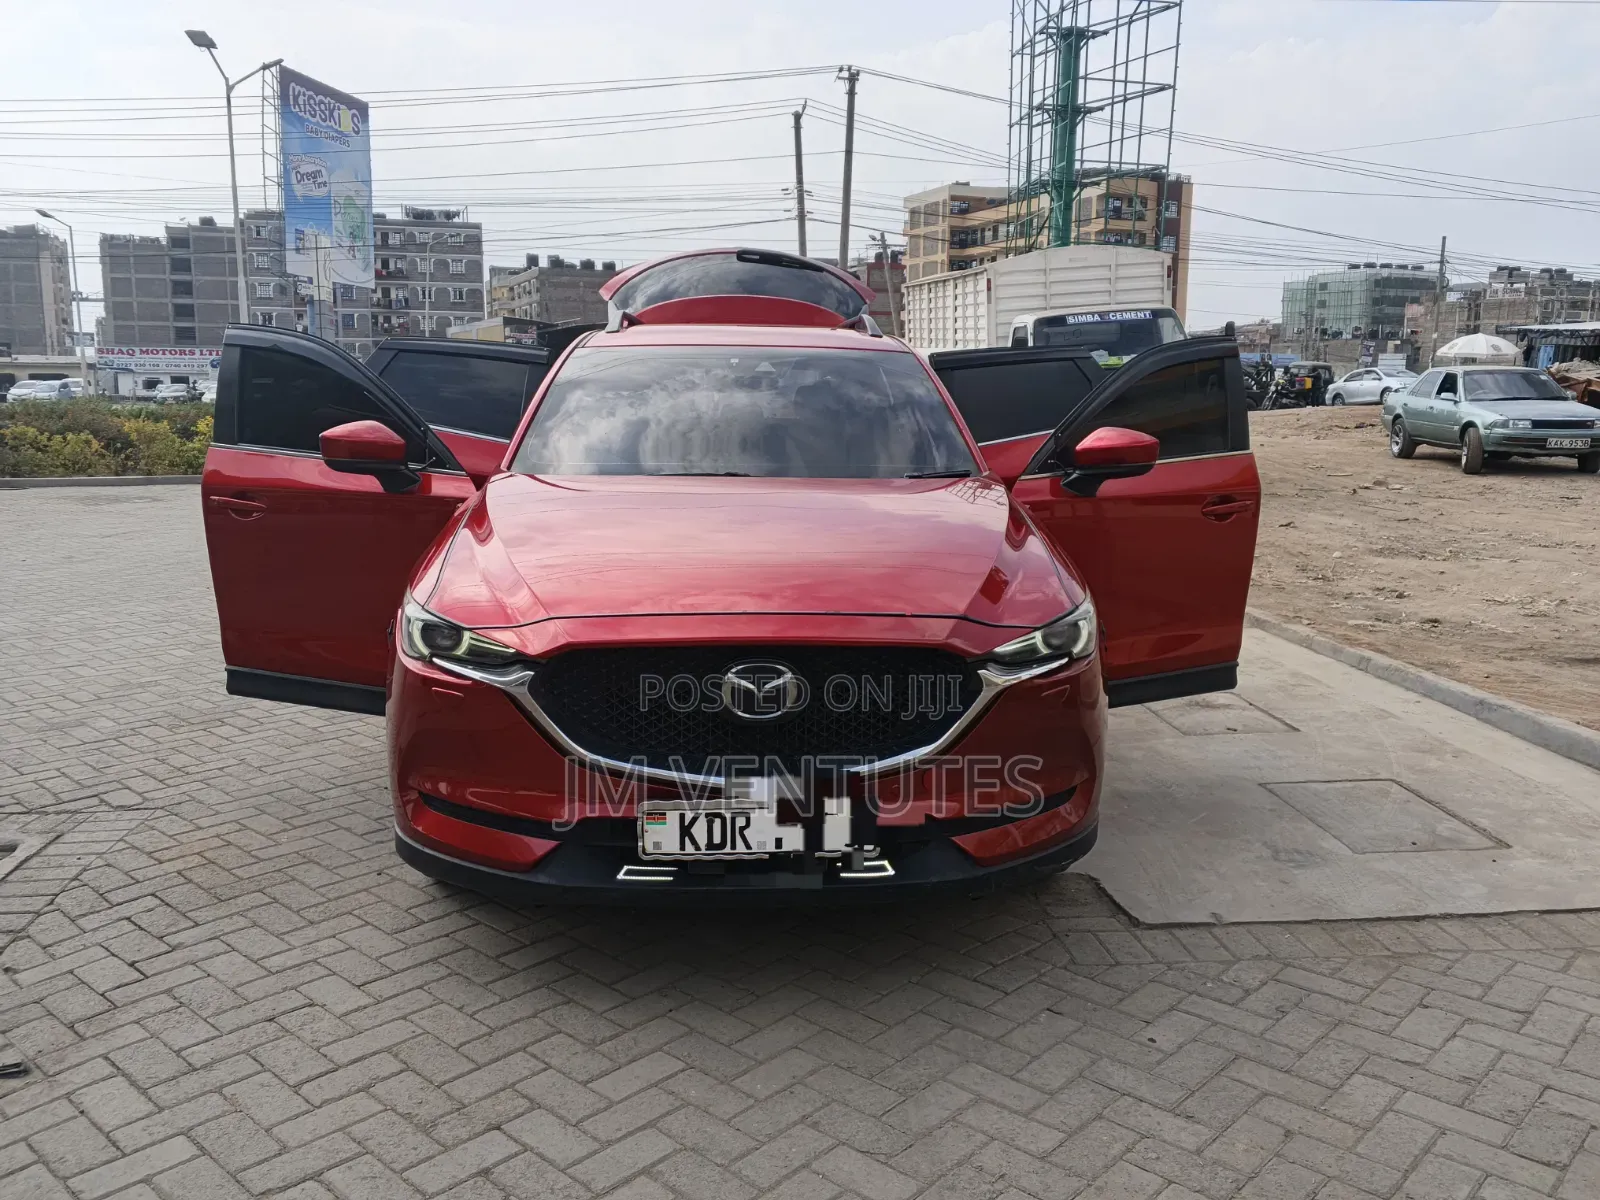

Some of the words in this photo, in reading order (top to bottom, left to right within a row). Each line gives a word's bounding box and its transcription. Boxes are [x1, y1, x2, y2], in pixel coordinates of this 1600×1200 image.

[305, 123, 323, 137] BABY
[324, 131, 351, 148] DIAPERS
[295, 169, 323, 184] Dream
[312, 180, 327, 189] Time
[1068, 314, 1101, 323] SIMBA
[1109, 311, 1151, 320] CEMENT
[97, 348, 136, 356] SHAQ
[139, 348, 196, 356] MOTORS
[1547, 439, 1565, 447] KAK
[679, 811, 753, 853] KDR
